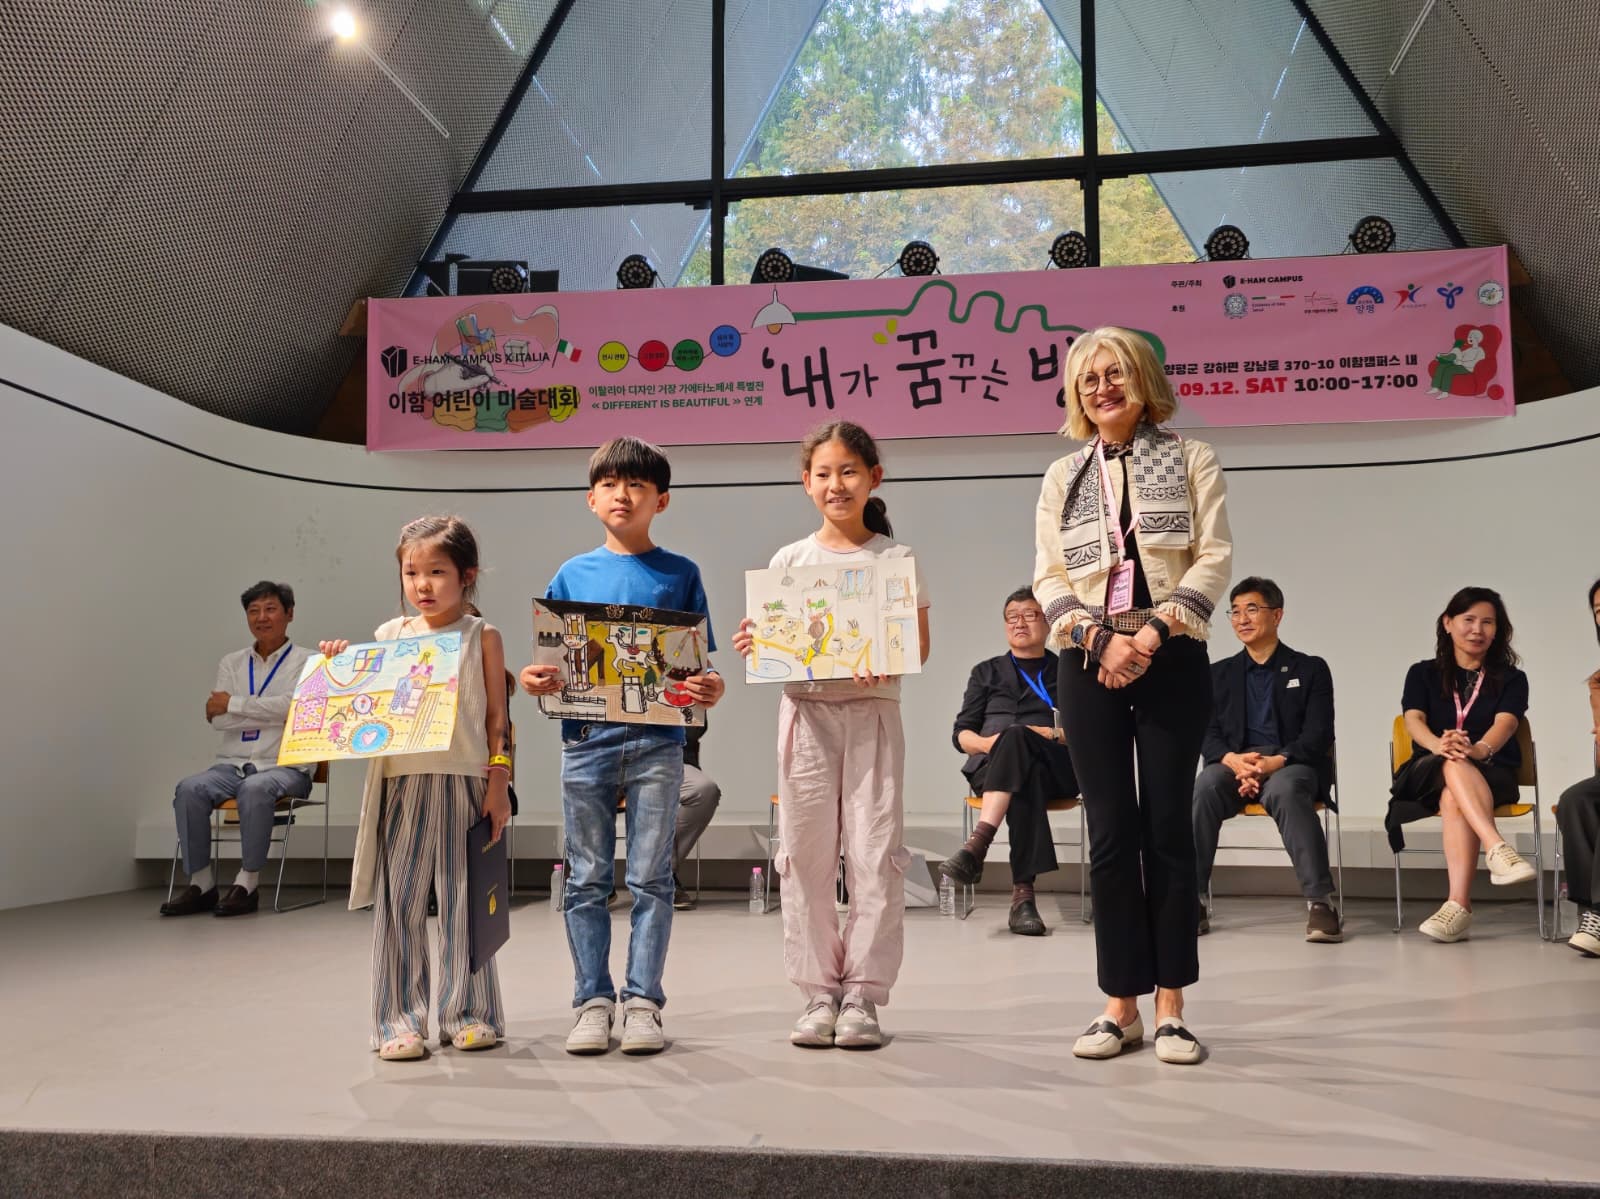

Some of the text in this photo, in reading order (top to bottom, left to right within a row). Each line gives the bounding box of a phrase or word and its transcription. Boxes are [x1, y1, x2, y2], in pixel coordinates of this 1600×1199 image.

[1240, 275, 1304, 285] E-HAM CAMPUS
[412, 355, 450, 366] E-HAM
[455, 353, 502, 364] CAMPUS
[515, 351, 550, 362] ITALIA
[1163, 354, 1418, 375] 양평군 강하면 강남로 370-10 이함캠퍼스 내
[896, 329, 1009, 410] 꿈꾸는
[588, 385, 626, 397] 이탈리아
[628, 385, 656, 396] 디자인
[657, 384, 678, 395] 거장
[735, 381, 765, 392] 특별전
[1245, 376, 1288, 394] SAT
[1294, 374, 1419, 392] 10:00-17:00
[388, 386, 578, 414] 이함 어린이 미술대회
[602, 400, 658, 410] DIFFERENT
[660, 400, 670, 408] IS
[672, 397, 730, 408] BEAUTIFUL
[744, 396, 763, 406] 연계
